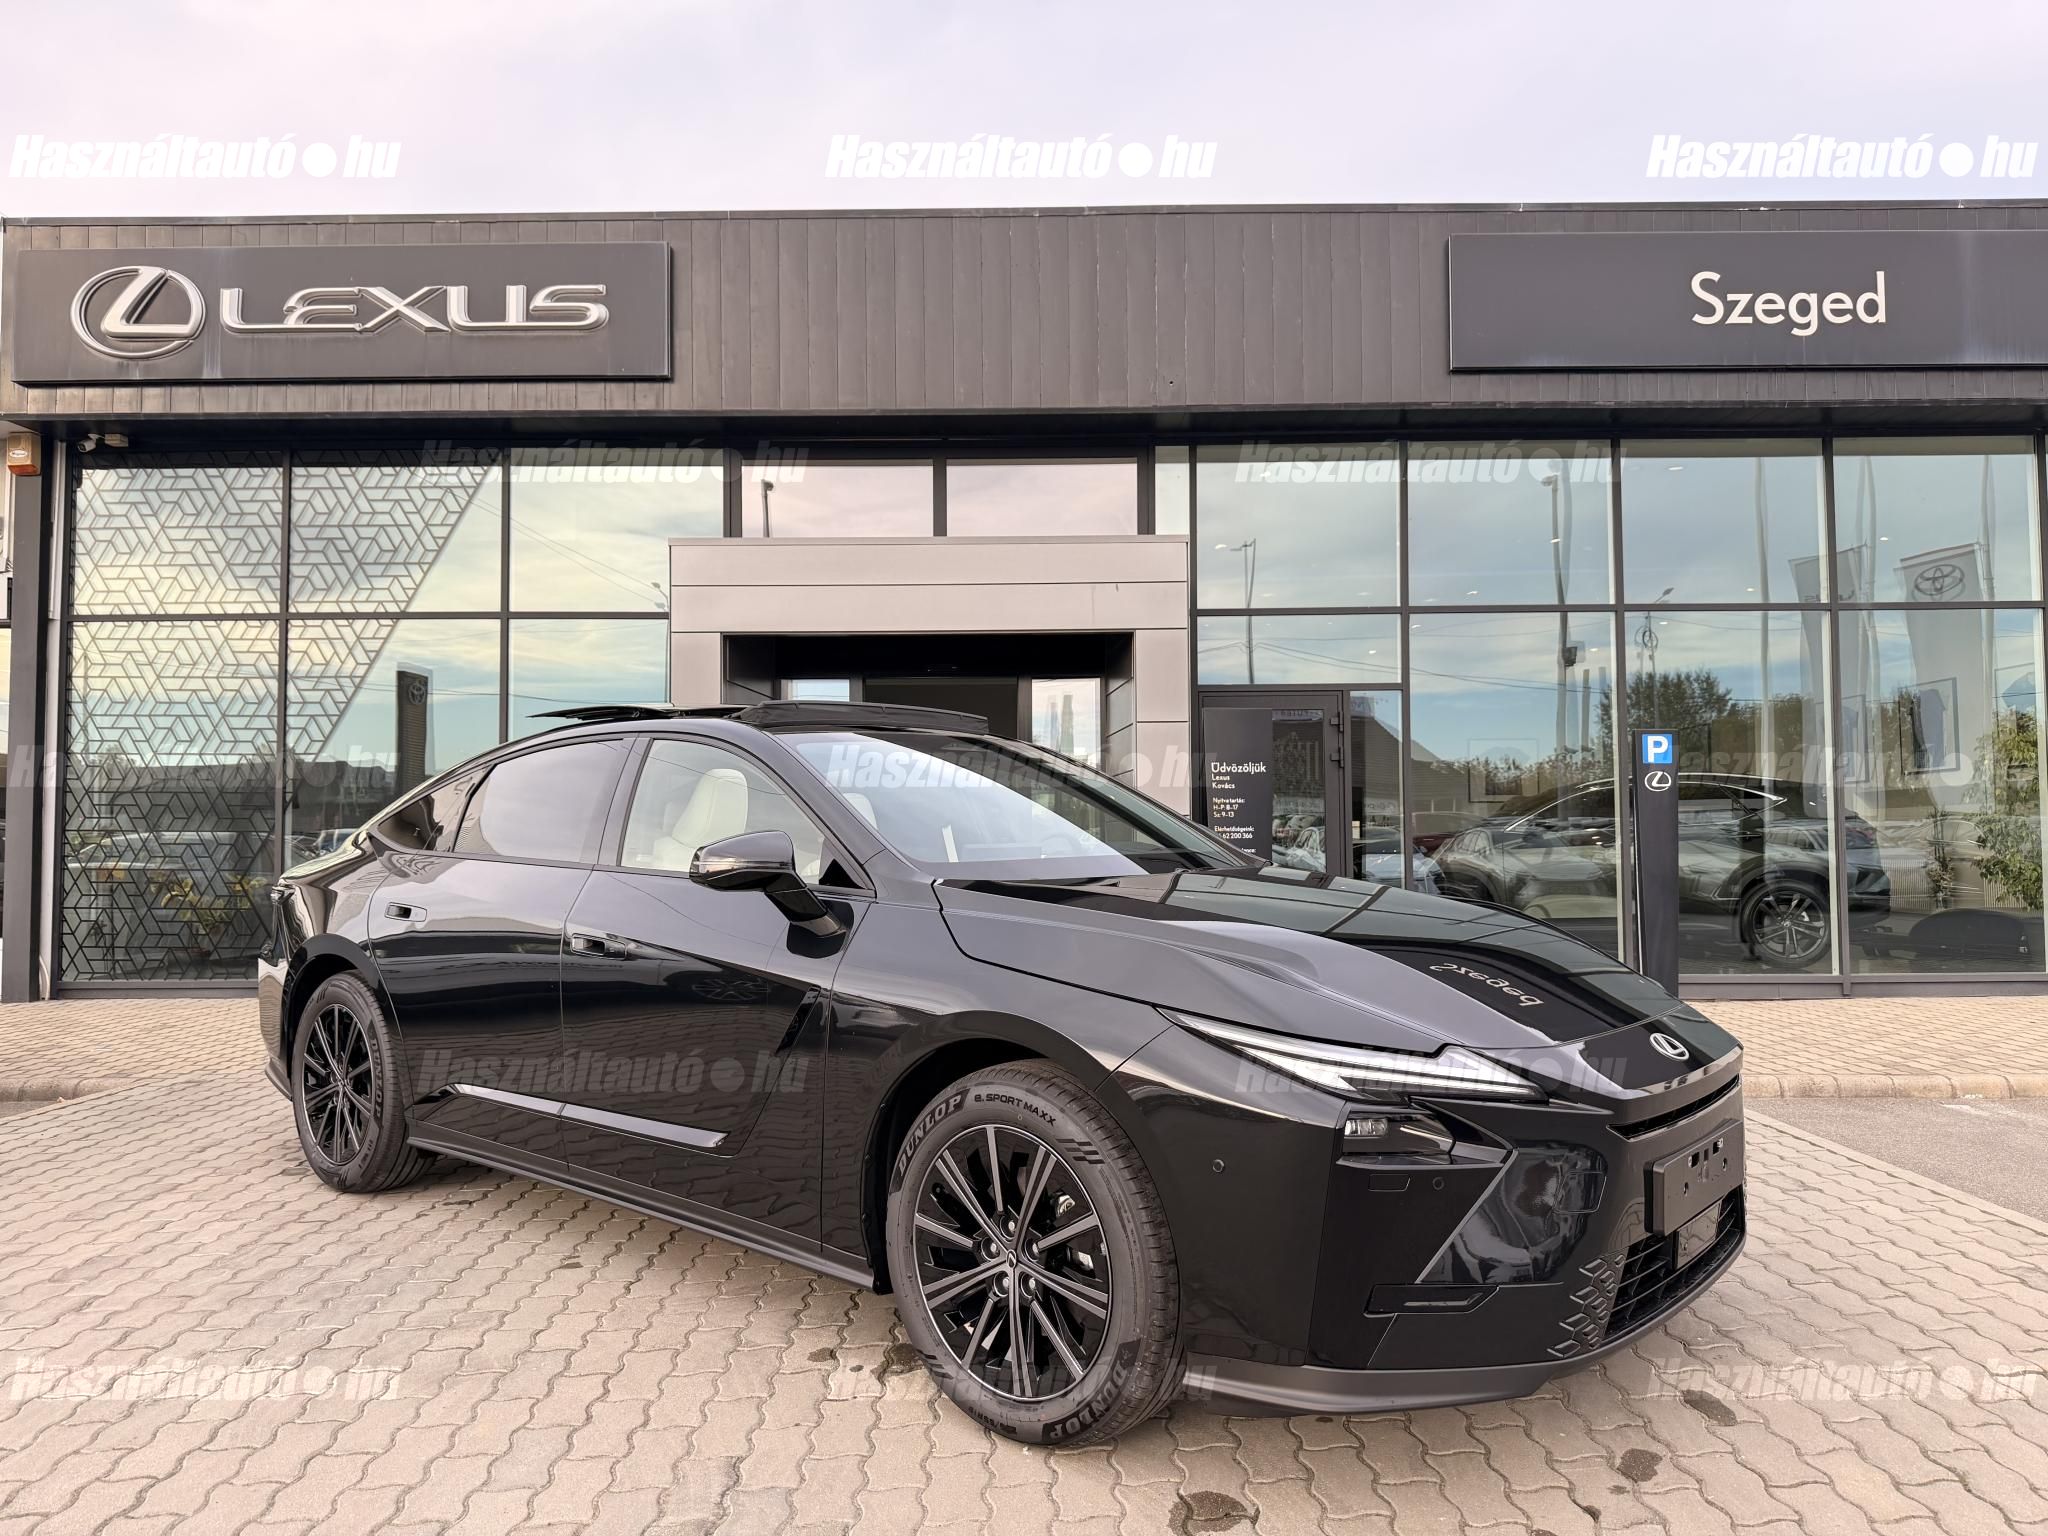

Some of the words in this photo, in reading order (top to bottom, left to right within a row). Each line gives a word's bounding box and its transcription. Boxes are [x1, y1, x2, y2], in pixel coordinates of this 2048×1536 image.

[220, 284, 609, 333] LEXUS
[1690, 270, 1887, 337] Szeged
[1211, 762, 1267, 775] Üdvözöljük
[1646, 735, 1669, 763] P
[986, 1093, 1023, 1108] SPORT
[1023, 1102, 1057, 1127] MAXX
[897, 1093, 964, 1177] DUNLOP
